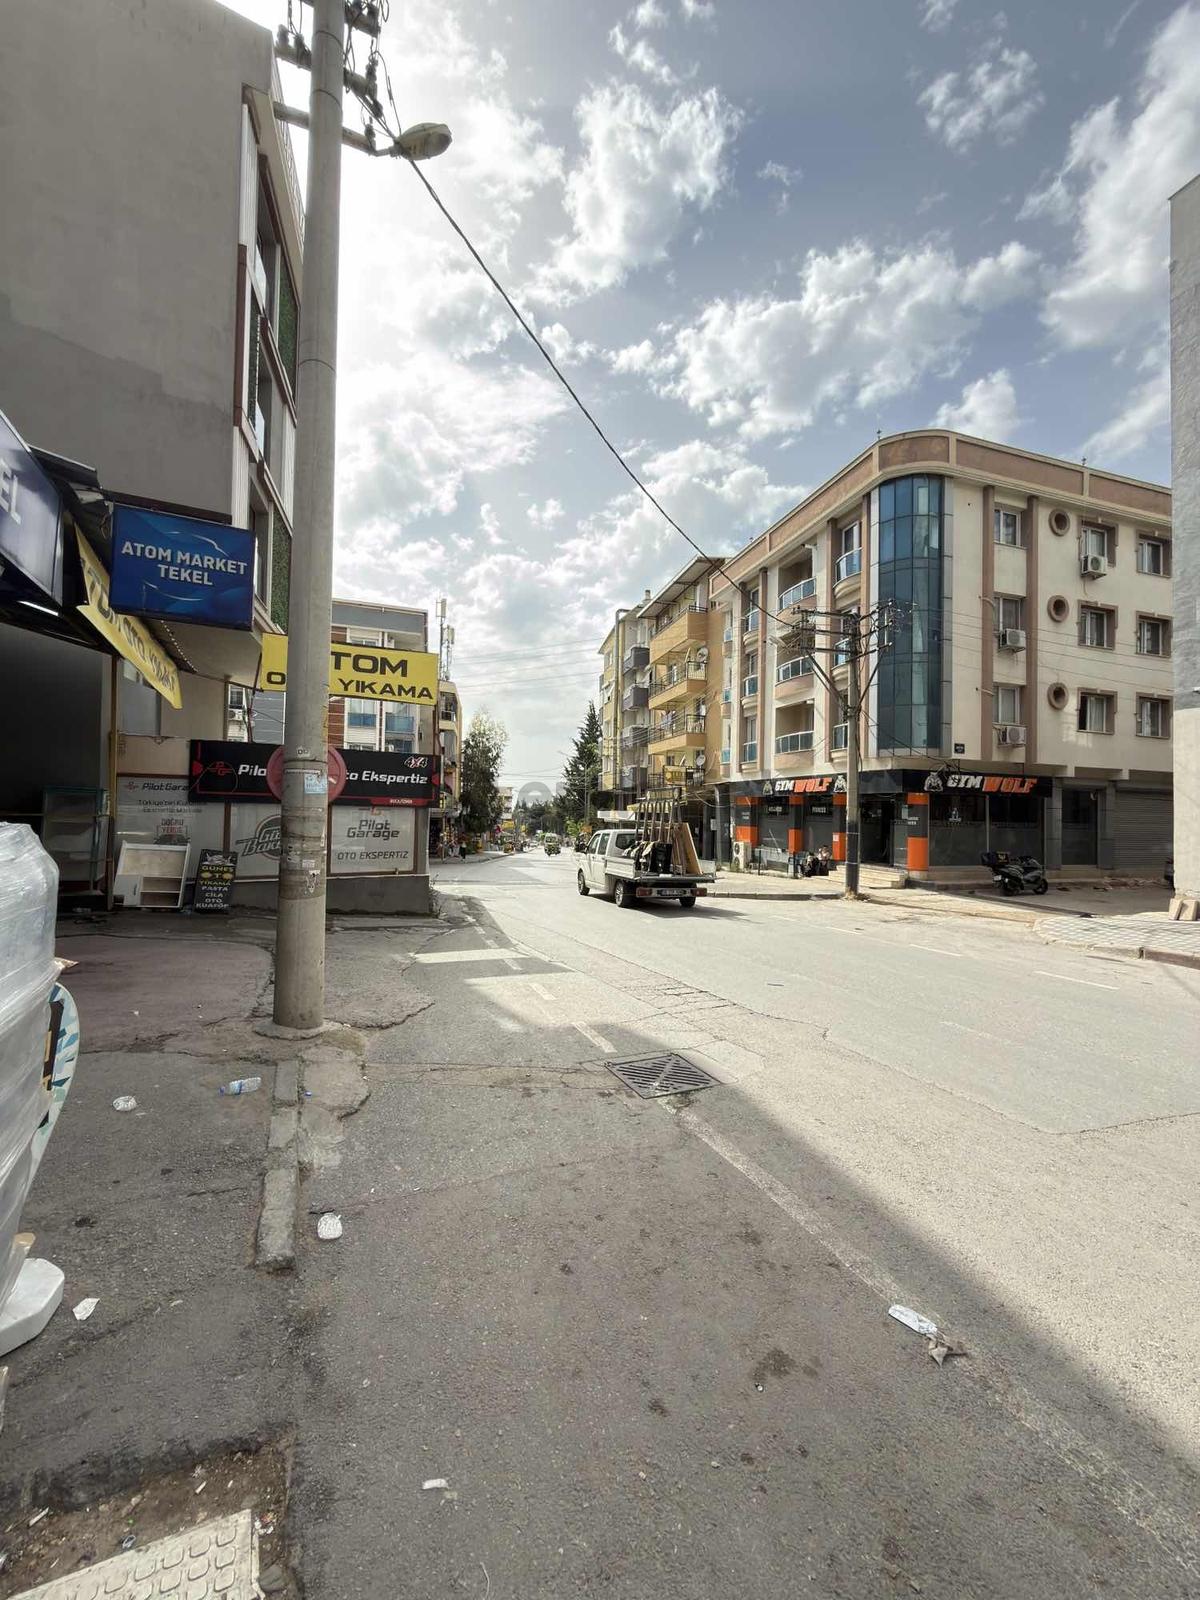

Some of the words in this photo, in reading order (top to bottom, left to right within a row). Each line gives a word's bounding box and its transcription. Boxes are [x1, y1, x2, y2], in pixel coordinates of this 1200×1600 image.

[121, 541, 172, 562] ATOM
[177, 551, 248, 575] MARKET
[157, 563, 213, 585] TEKEL
[331, 651, 408, 678] TOM
[337, 678, 434, 700] YIKAMA
[238, 764, 267, 776] Pilo
[361, 770, 428, 785] Ekspertiz
[947, 774, 983, 789] GYM
[982, 776, 1038, 793] WOLF
[775, 780, 795, 791] GYM
[346, 827, 400, 841] Garage
[359, 819, 391, 830] Pilot
[337, 851, 357, 861] OTO
